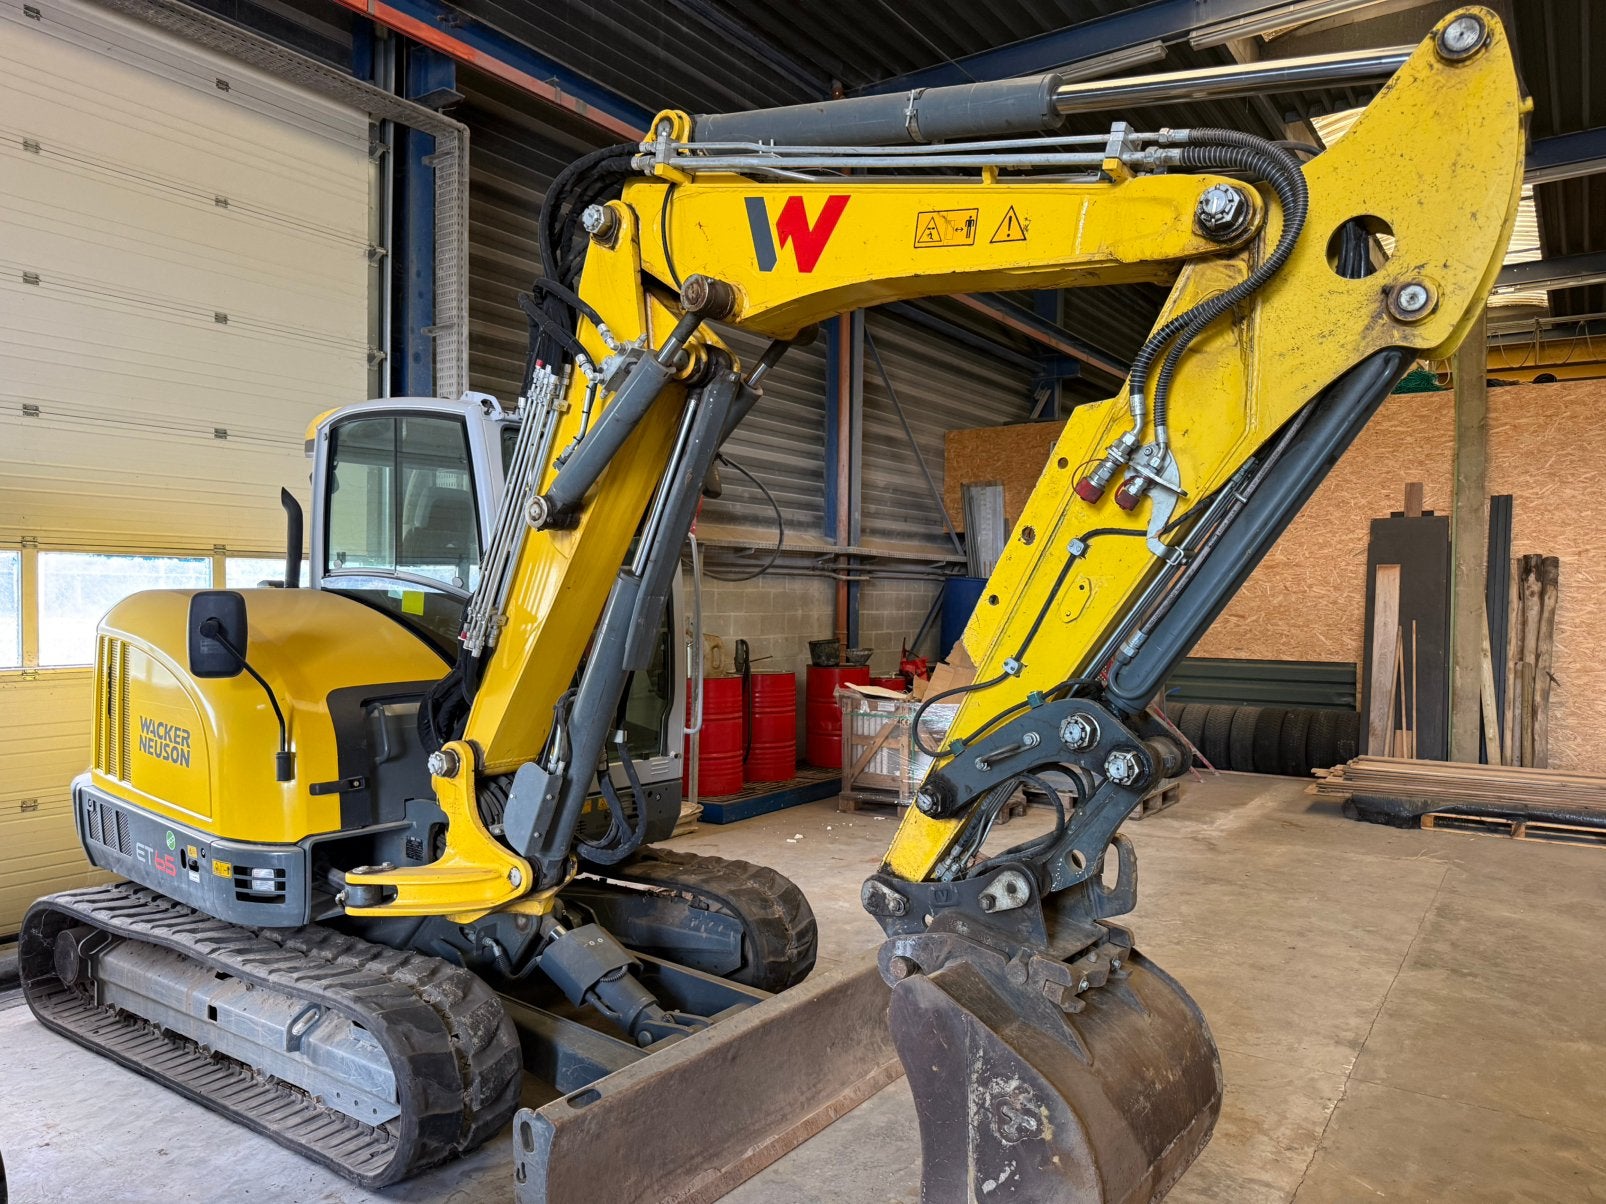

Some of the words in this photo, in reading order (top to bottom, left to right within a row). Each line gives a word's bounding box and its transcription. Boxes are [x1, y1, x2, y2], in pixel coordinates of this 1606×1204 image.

[140, 715, 191, 749] WACKER
[139, 735, 191, 769] NEUSON
[135, 842, 177, 877] ET65
